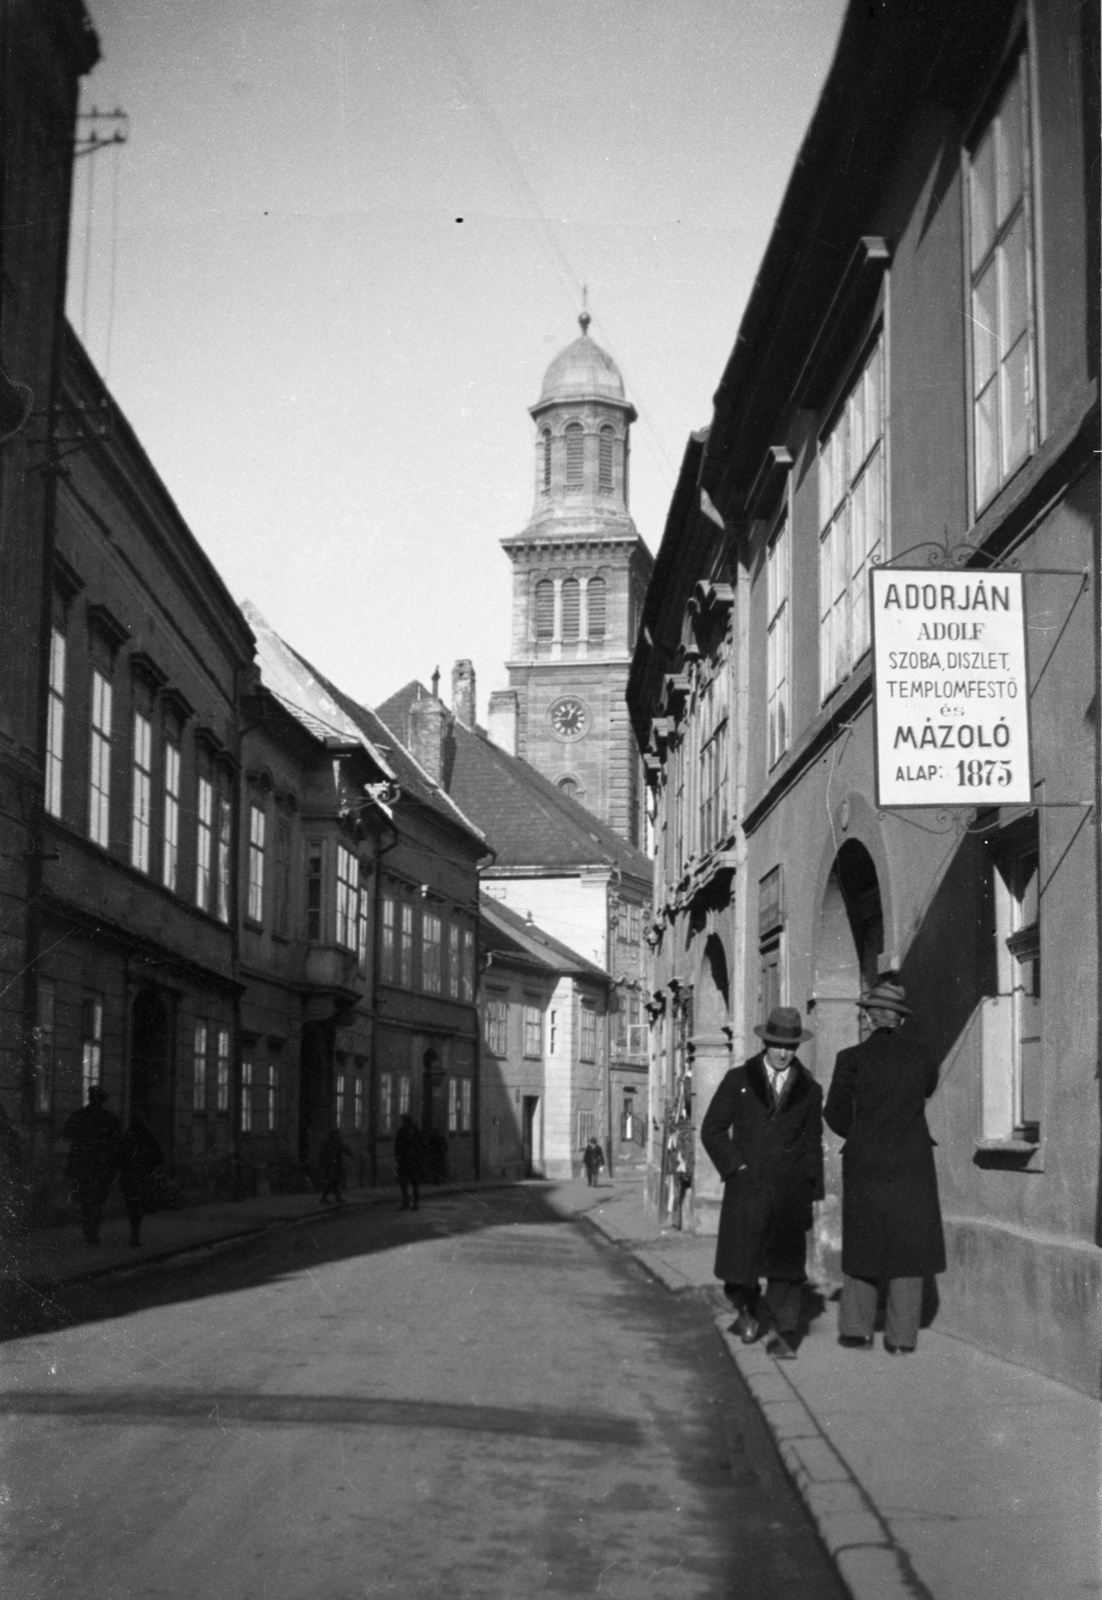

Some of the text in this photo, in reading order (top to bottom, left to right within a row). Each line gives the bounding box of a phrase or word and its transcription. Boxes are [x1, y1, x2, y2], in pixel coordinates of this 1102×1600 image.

[884, 580, 1010, 611] ADORJÁN
[917, 622, 985, 641] ADOLF
[940, 704, 965, 717] és
[894, 716, 1010, 749] MÁZOLÓ
[956, 759, 1012, 787] 1875
